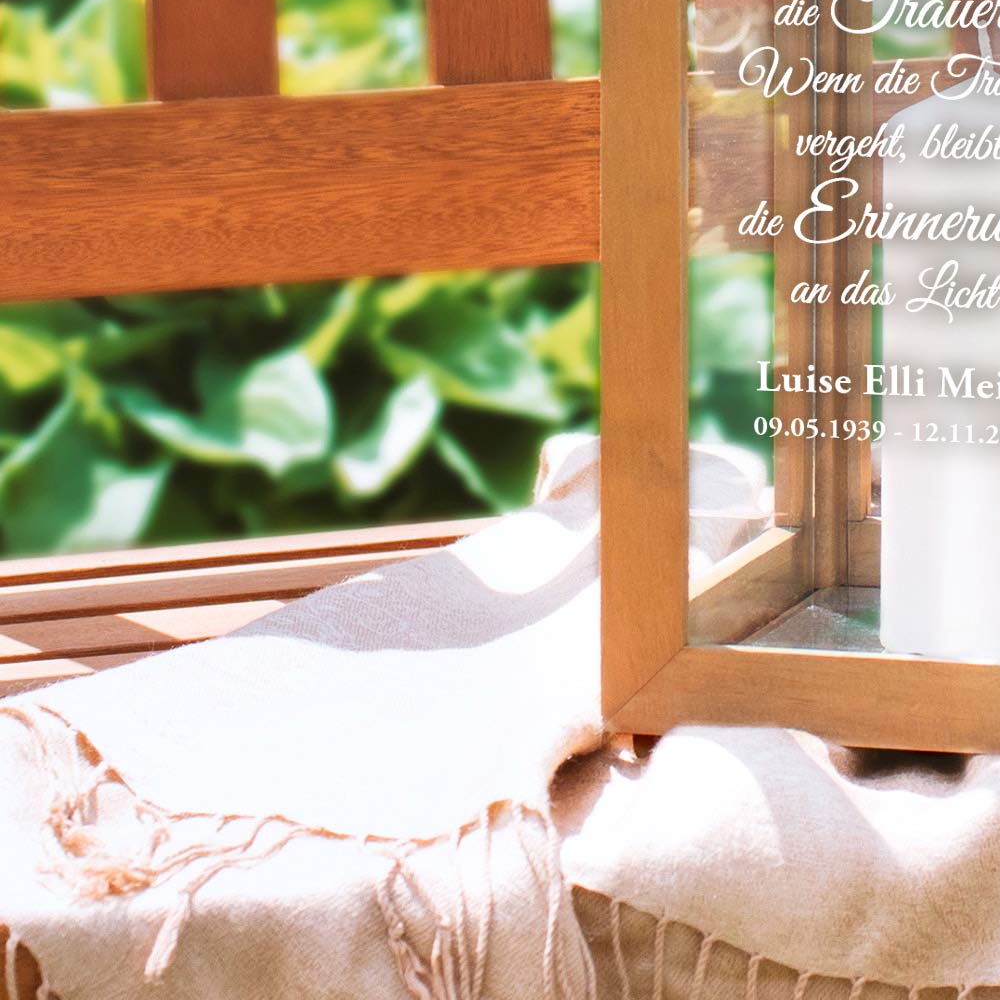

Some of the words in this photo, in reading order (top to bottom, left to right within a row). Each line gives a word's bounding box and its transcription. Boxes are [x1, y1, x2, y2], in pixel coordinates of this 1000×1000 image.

[738, 46, 864, 98] Wenn
[874, 58, 920, 94] die
[796, 122, 907, 174] vergeht,
[738, 200, 784, 237] die
[790, 281, 831, 304] an
[840, 270, 896, 306] das
[756, 360, 852, 394] Luise
[863, 363, 926, 397] Elli
[753, 416, 886, 442] 09.05.1939
